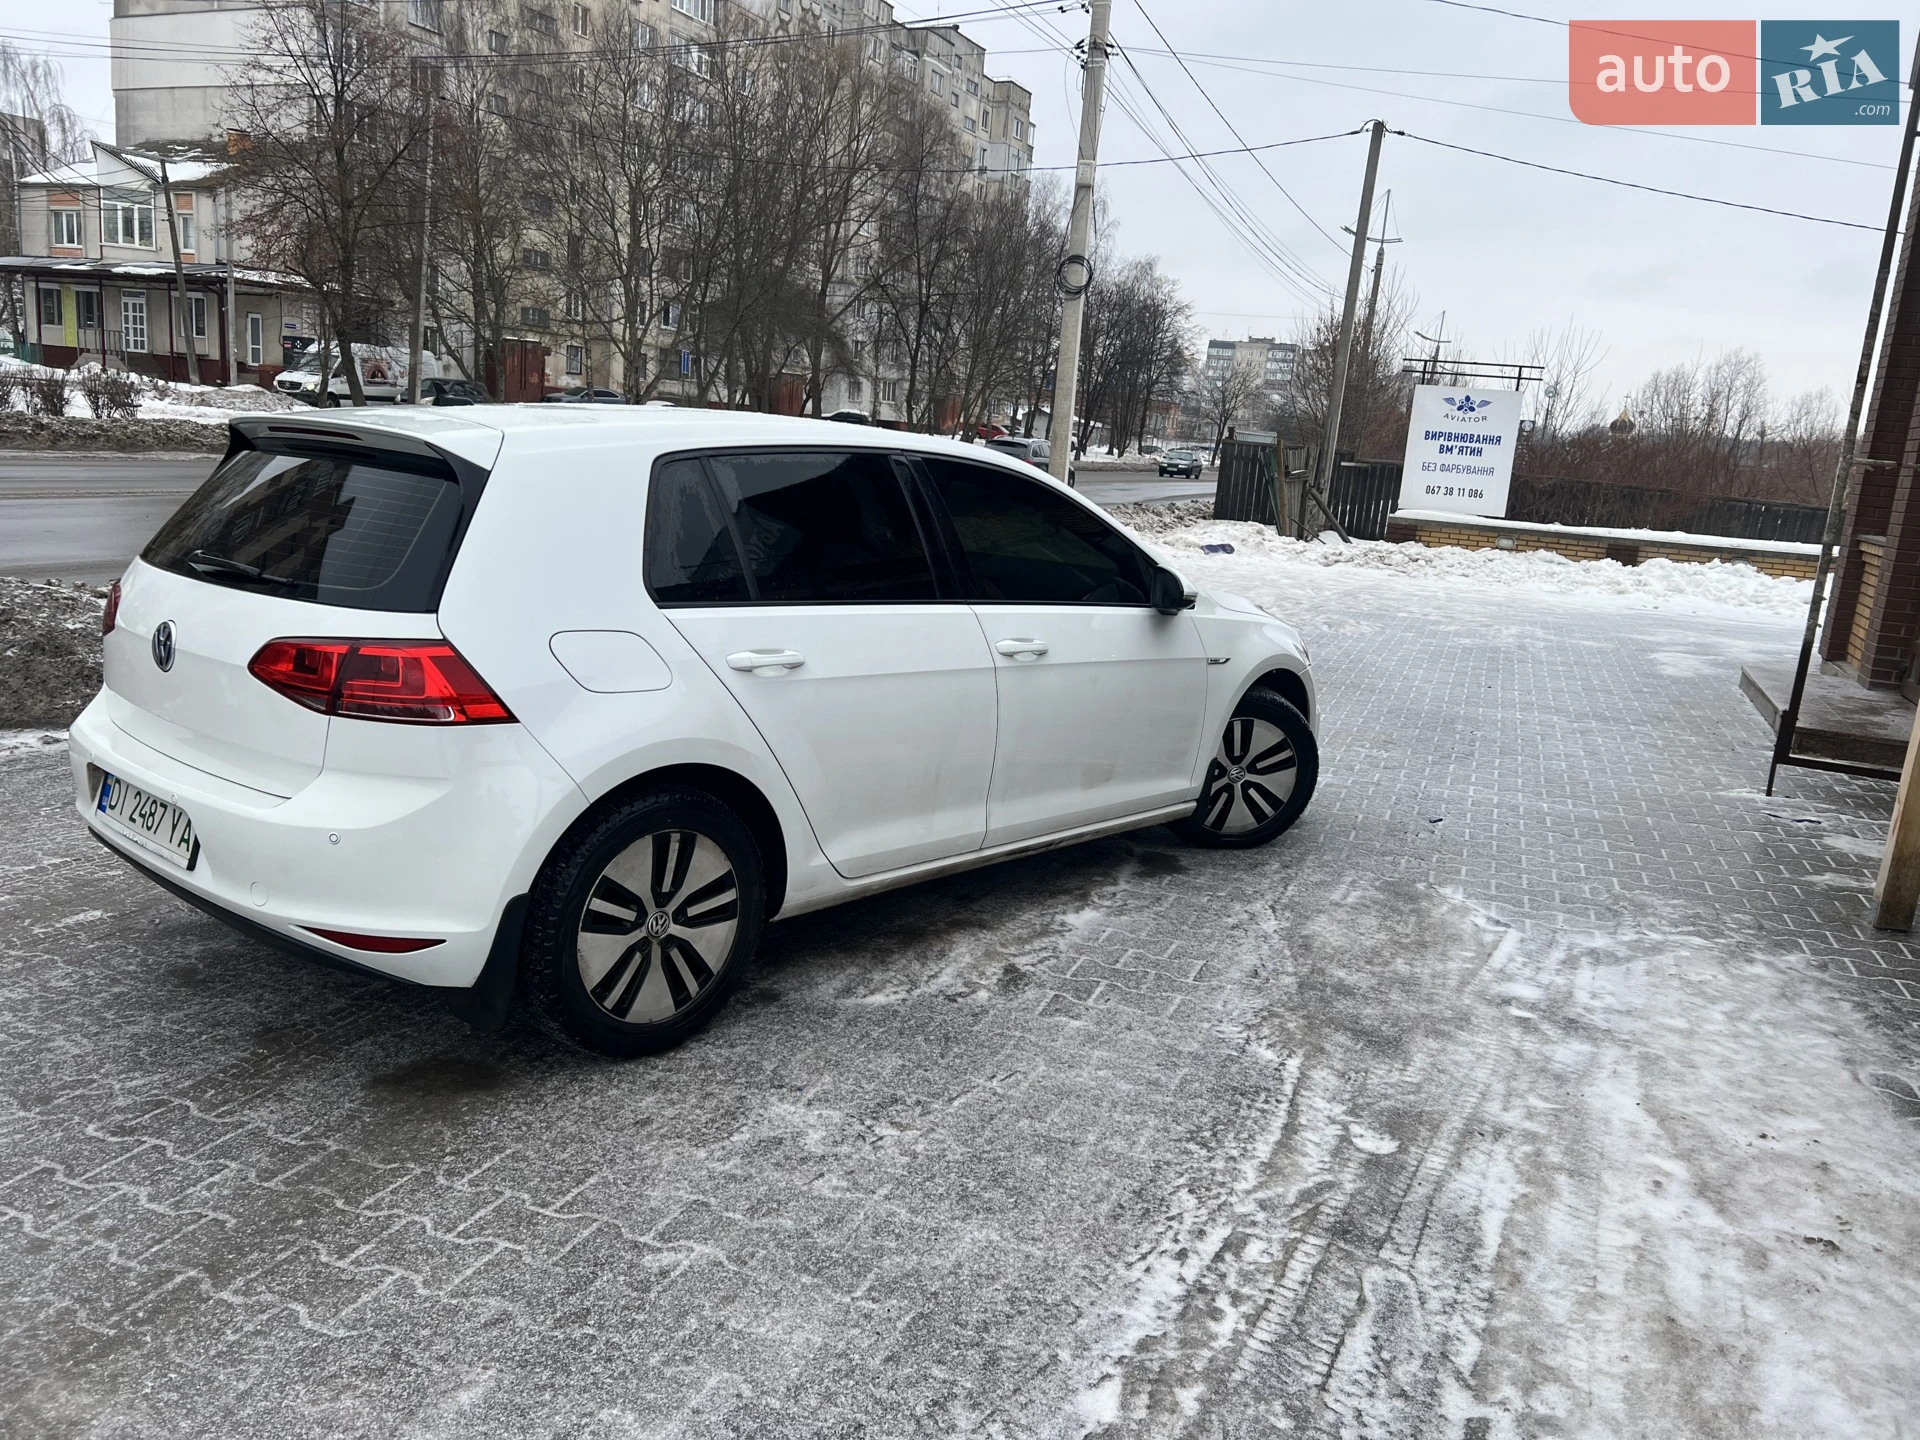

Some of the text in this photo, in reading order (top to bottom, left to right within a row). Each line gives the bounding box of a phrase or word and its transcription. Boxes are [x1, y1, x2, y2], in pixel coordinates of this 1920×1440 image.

[1443, 413, 1488, 422] AVIATOR
[1424, 430, 1502, 446] ВИРІВНЮВАННЯ
[1421, 462, 1495, 476] БЕЗ ФАРБУВАННЯ
[1425, 485, 1484, 499] 067 38 11 086
[108, 777, 129, 816] DI
[128, 790, 168, 835] 2487
[169, 807, 192, 852] YA
